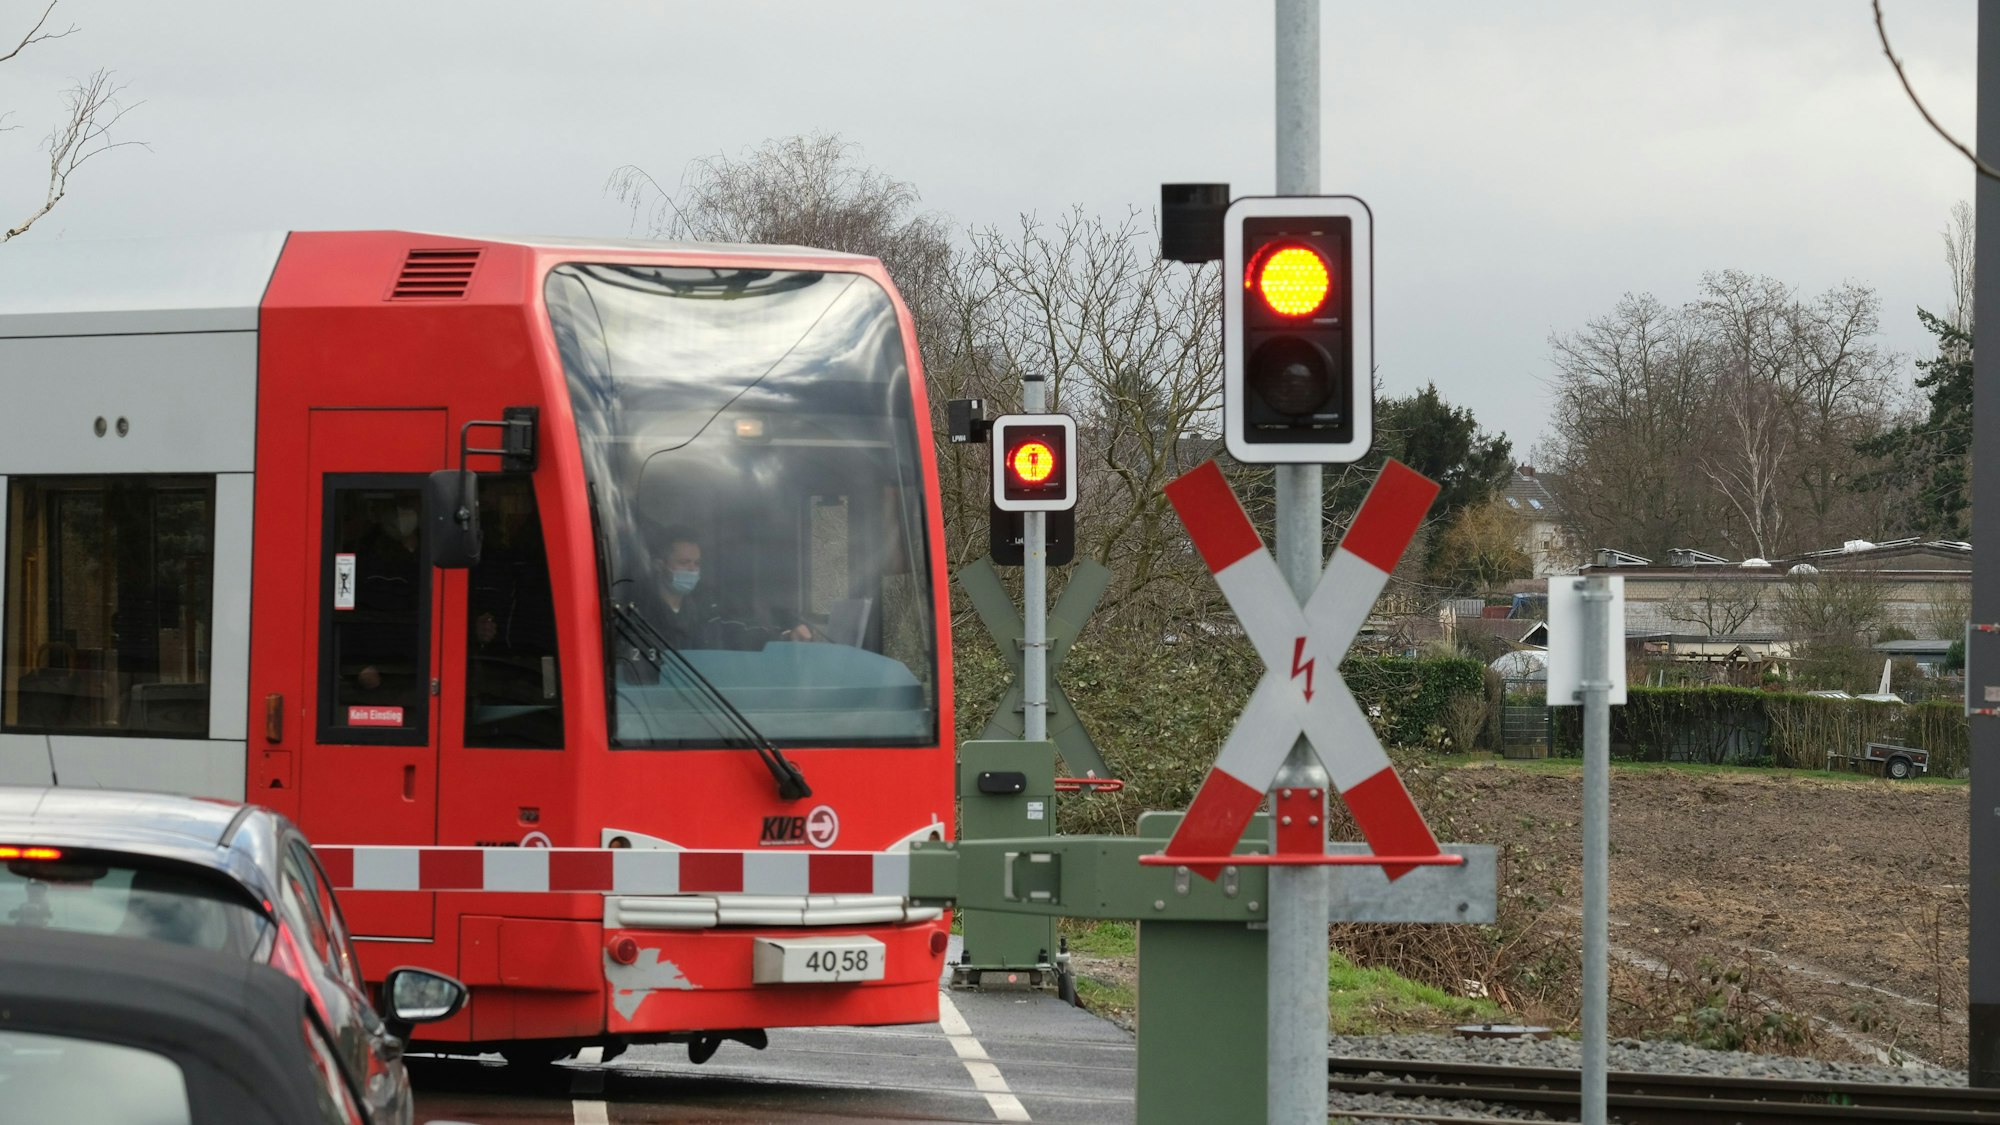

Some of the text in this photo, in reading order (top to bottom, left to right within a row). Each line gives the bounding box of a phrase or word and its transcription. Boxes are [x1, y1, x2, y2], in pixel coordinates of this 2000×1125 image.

[350, 709, 402, 723] Kein Einstieg
[761, 816, 806, 841] KVB
